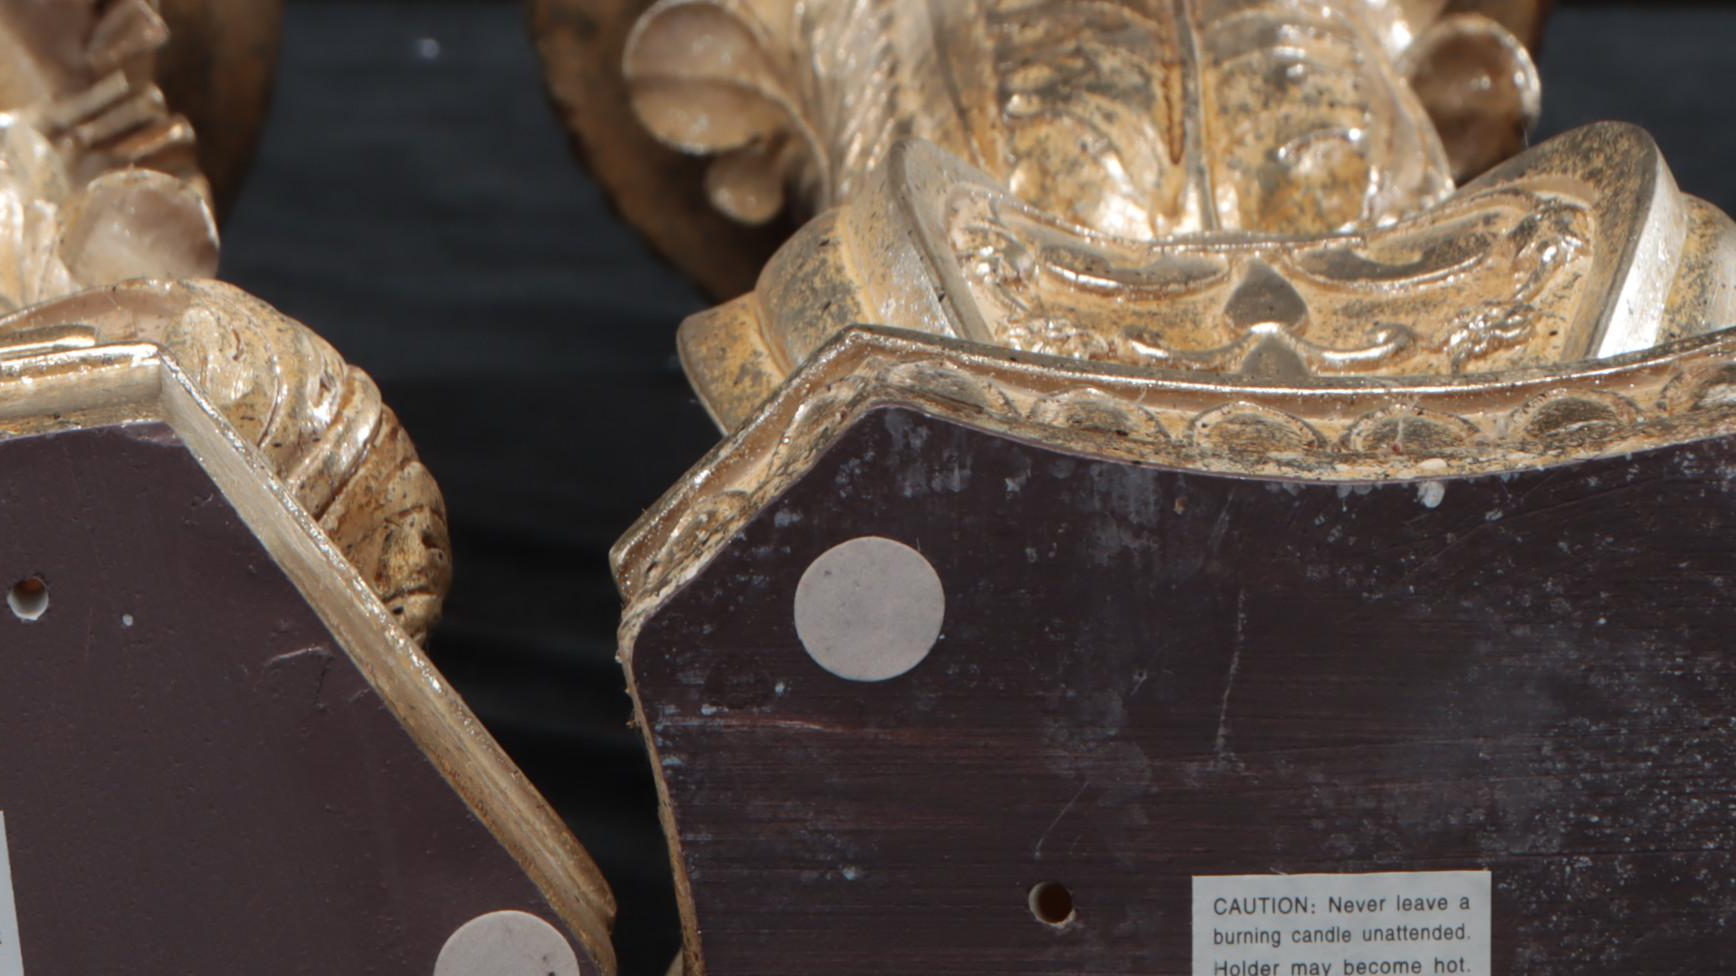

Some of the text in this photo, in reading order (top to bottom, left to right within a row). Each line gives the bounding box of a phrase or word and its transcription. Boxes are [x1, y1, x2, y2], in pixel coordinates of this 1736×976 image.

[1213, 895, 1471, 916] CAUTION: Never leave a
[1213, 923, 1471, 948] burning candle unattended.
[1343, 957, 1423, 976] become
[1433, 956, 1471, 975] hot.
